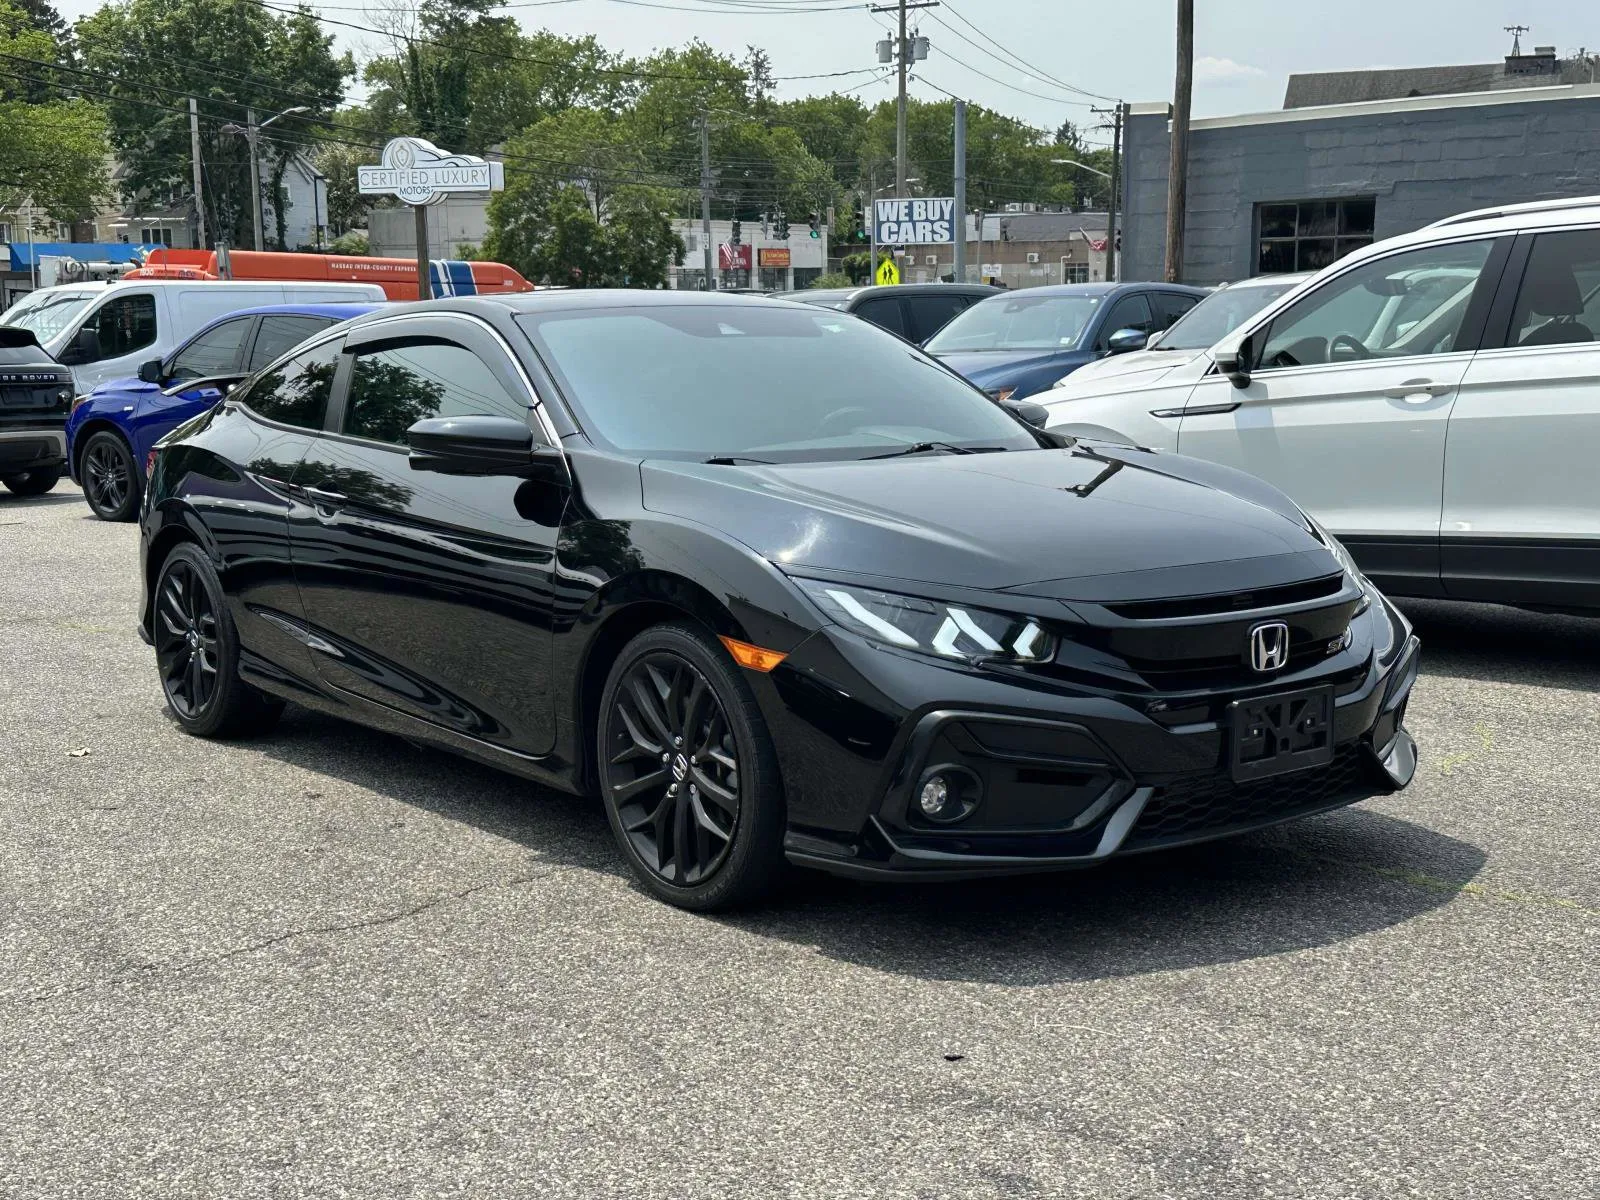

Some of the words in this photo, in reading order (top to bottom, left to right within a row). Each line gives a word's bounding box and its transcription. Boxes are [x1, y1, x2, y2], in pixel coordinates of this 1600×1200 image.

[360, 170, 429, 186] CERTIFIED
[435, 169, 488, 184] LUXURY
[399, 186, 431, 195] MOTORS
[877, 201, 909, 221] WE
[912, 200, 953, 220] BUY
[880, 221, 950, 243] CARS
